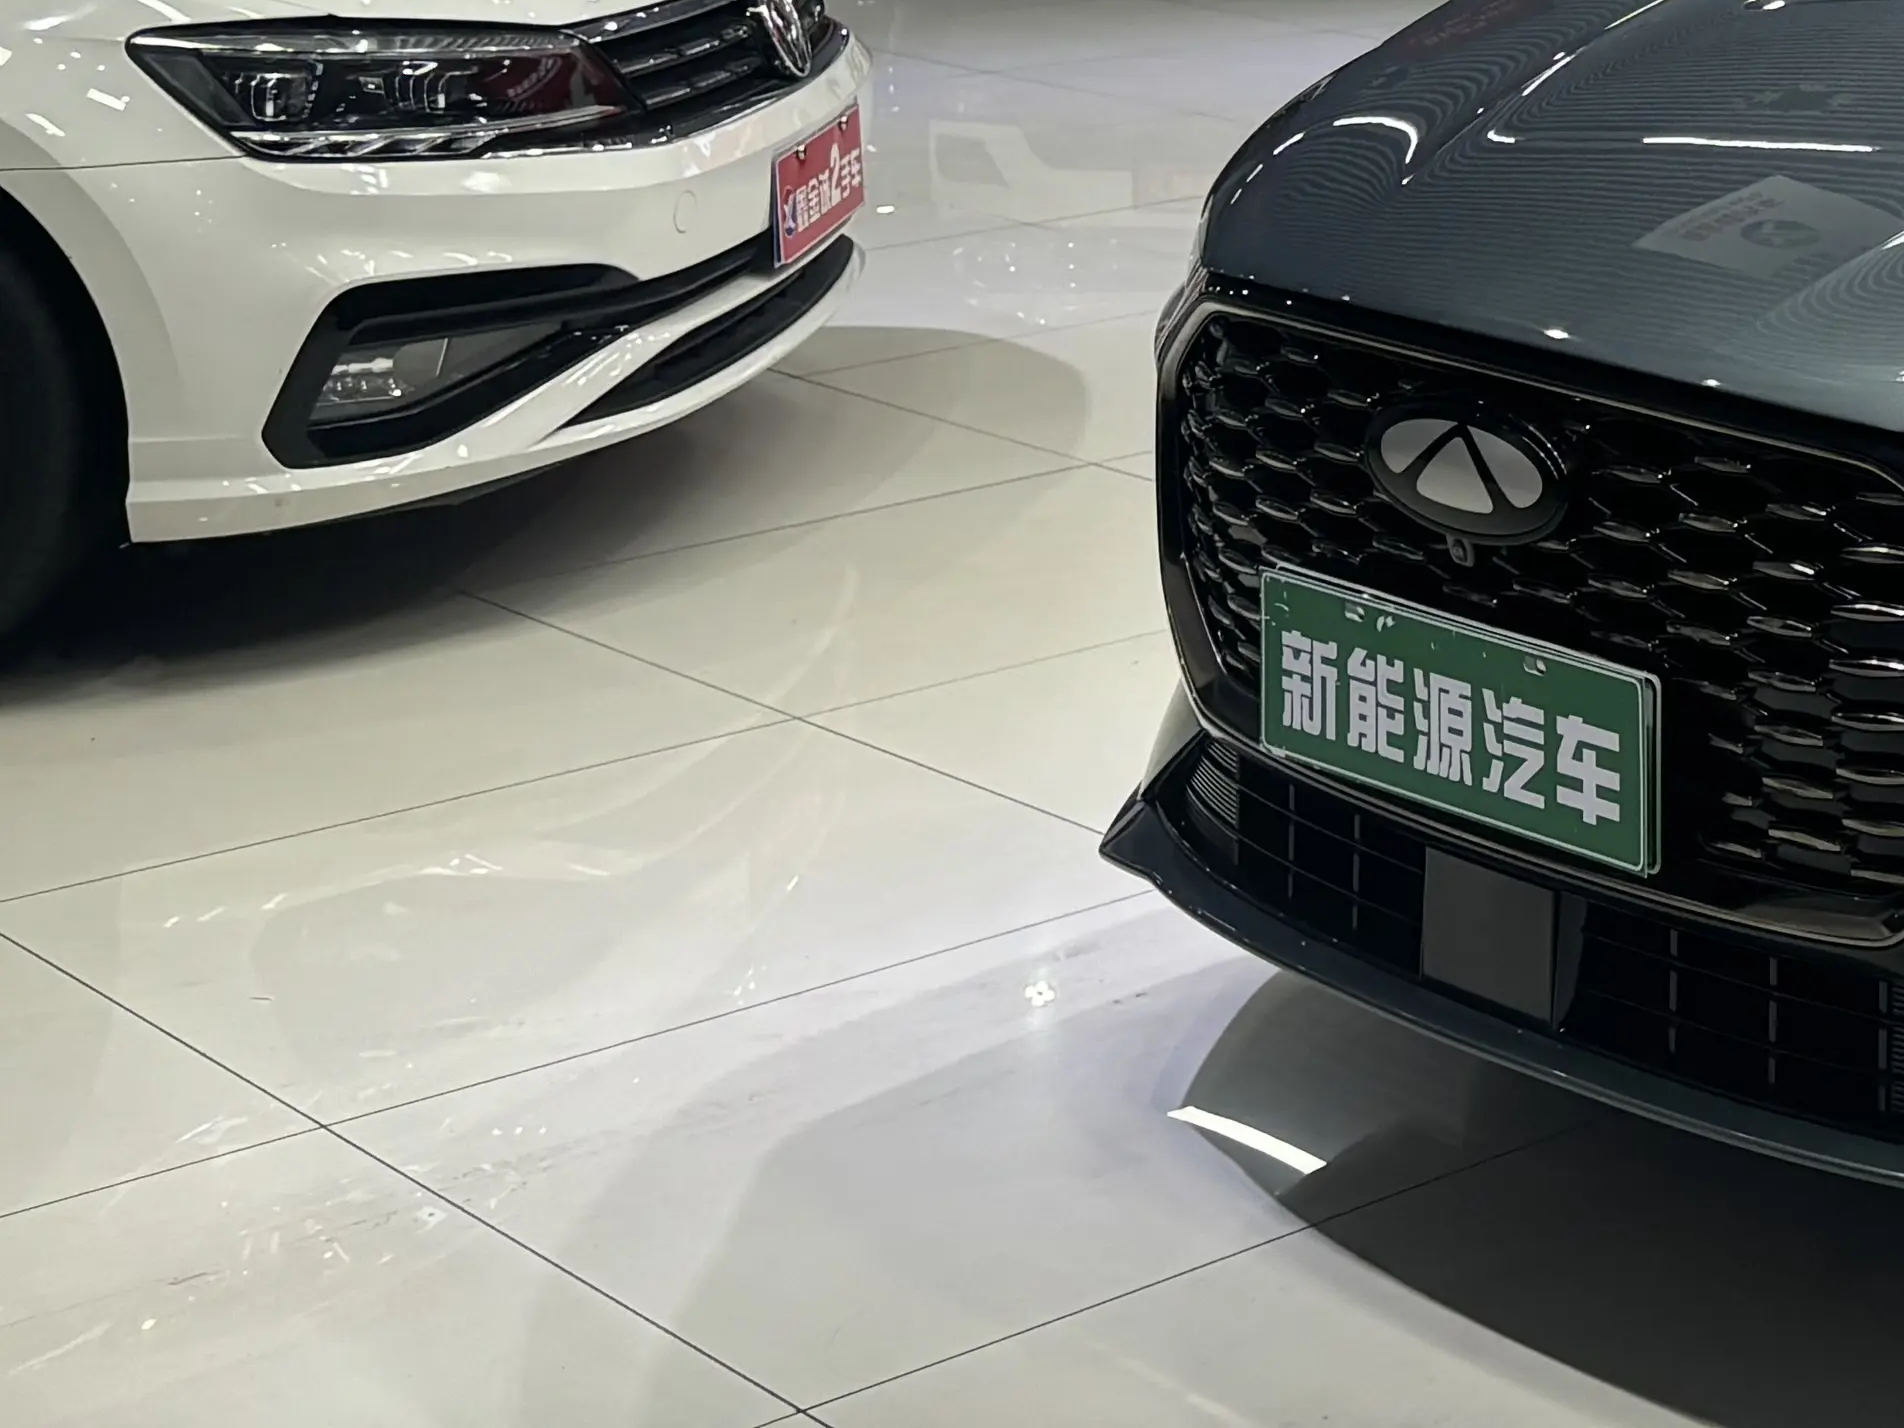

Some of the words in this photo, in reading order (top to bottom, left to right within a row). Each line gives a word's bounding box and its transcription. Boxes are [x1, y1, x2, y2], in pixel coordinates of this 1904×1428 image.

[796, 142, 862, 233] 鑫金诚2手车
[1281, 629, 1621, 826] 新能源汽车
